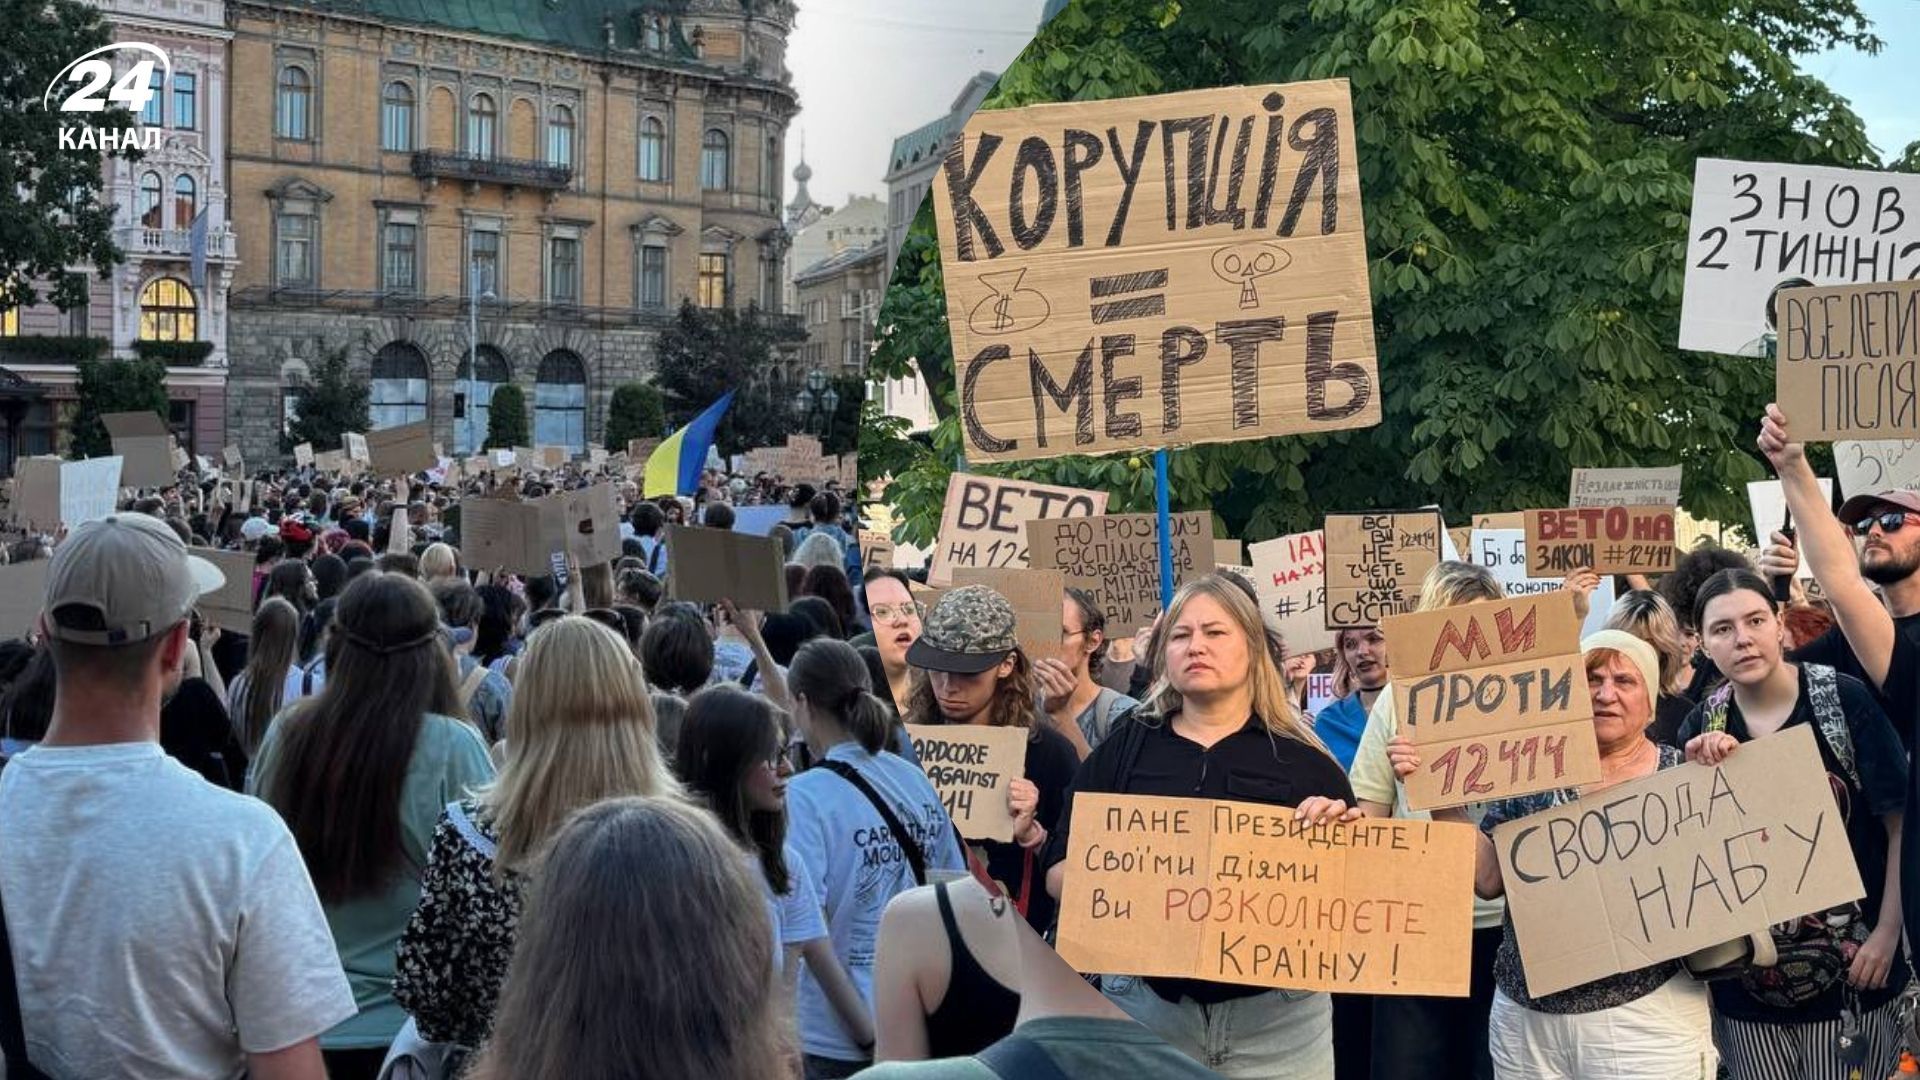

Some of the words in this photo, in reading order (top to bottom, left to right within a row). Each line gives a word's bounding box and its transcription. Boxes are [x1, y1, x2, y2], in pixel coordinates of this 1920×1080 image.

[1696, 226, 1730, 270] 2
[963, 310, 1371, 453] СМЕРТЬ
[1822, 361, 1917, 431] ПІСЛЯ
[1053, 520, 1094, 546] ДО
[1371, 529, 1394, 543] ВИ
[1537, 506, 1629, 541] ВЕТО
[1632, 513, 1676, 541] НА
[948, 541, 976, 567] НА
[1362, 543, 1396, 564] НЕ
[1535, 543, 1595, 571] ЗАКОН
[1602, 543, 1673, 568] #12414
[1103, 574, 1183, 593] МІТИНИ
[1356, 589, 1404, 605] КАЖЕ
[1429, 604, 1537, 672] МИ
[1407, 666, 1572, 726] ПРОТИ
[907, 733, 989, 765] ARDCORE
[1430, 735, 1568, 796] 12414
[1106, 806, 1191, 834] ПАНЕ
[1510, 767, 1746, 884] СВОБОДА
[1630, 811, 1824, 943] НАБУ
[1164, 887, 1427, 935] РОЗКОЛЮЄТЕ
